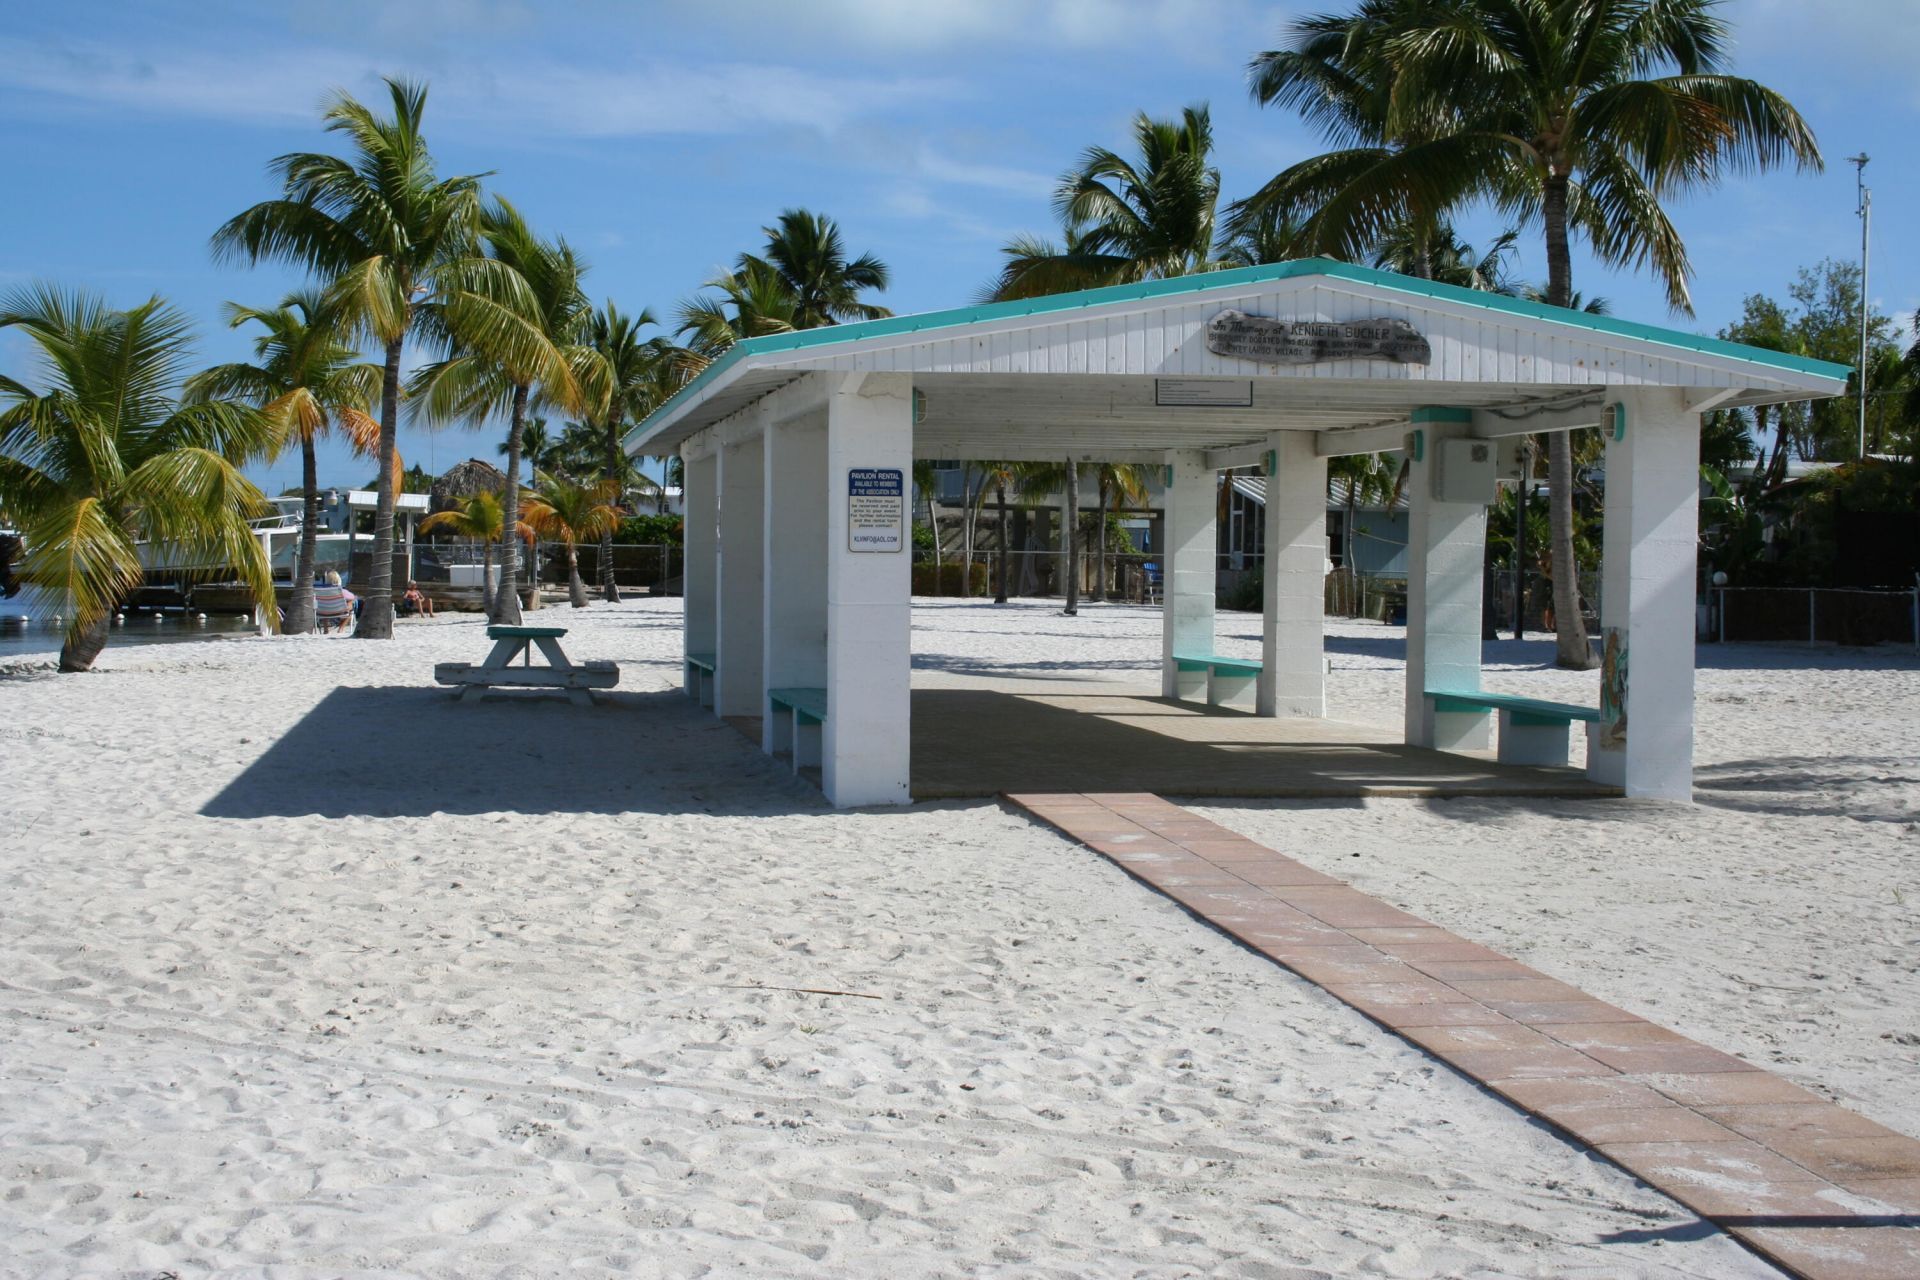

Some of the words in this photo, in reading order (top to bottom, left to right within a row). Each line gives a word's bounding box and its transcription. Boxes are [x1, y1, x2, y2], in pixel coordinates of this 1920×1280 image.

[1212, 320, 1226, 331] In
[1291, 324, 1338, 337] KENNETH
[1345, 327, 1390, 340] BUCHER
[1297, 338, 1328, 348] BEAUTL
[1275, 348, 1304, 356] VILLAGE
[1311, 349, 1353, 358] RDENTS
